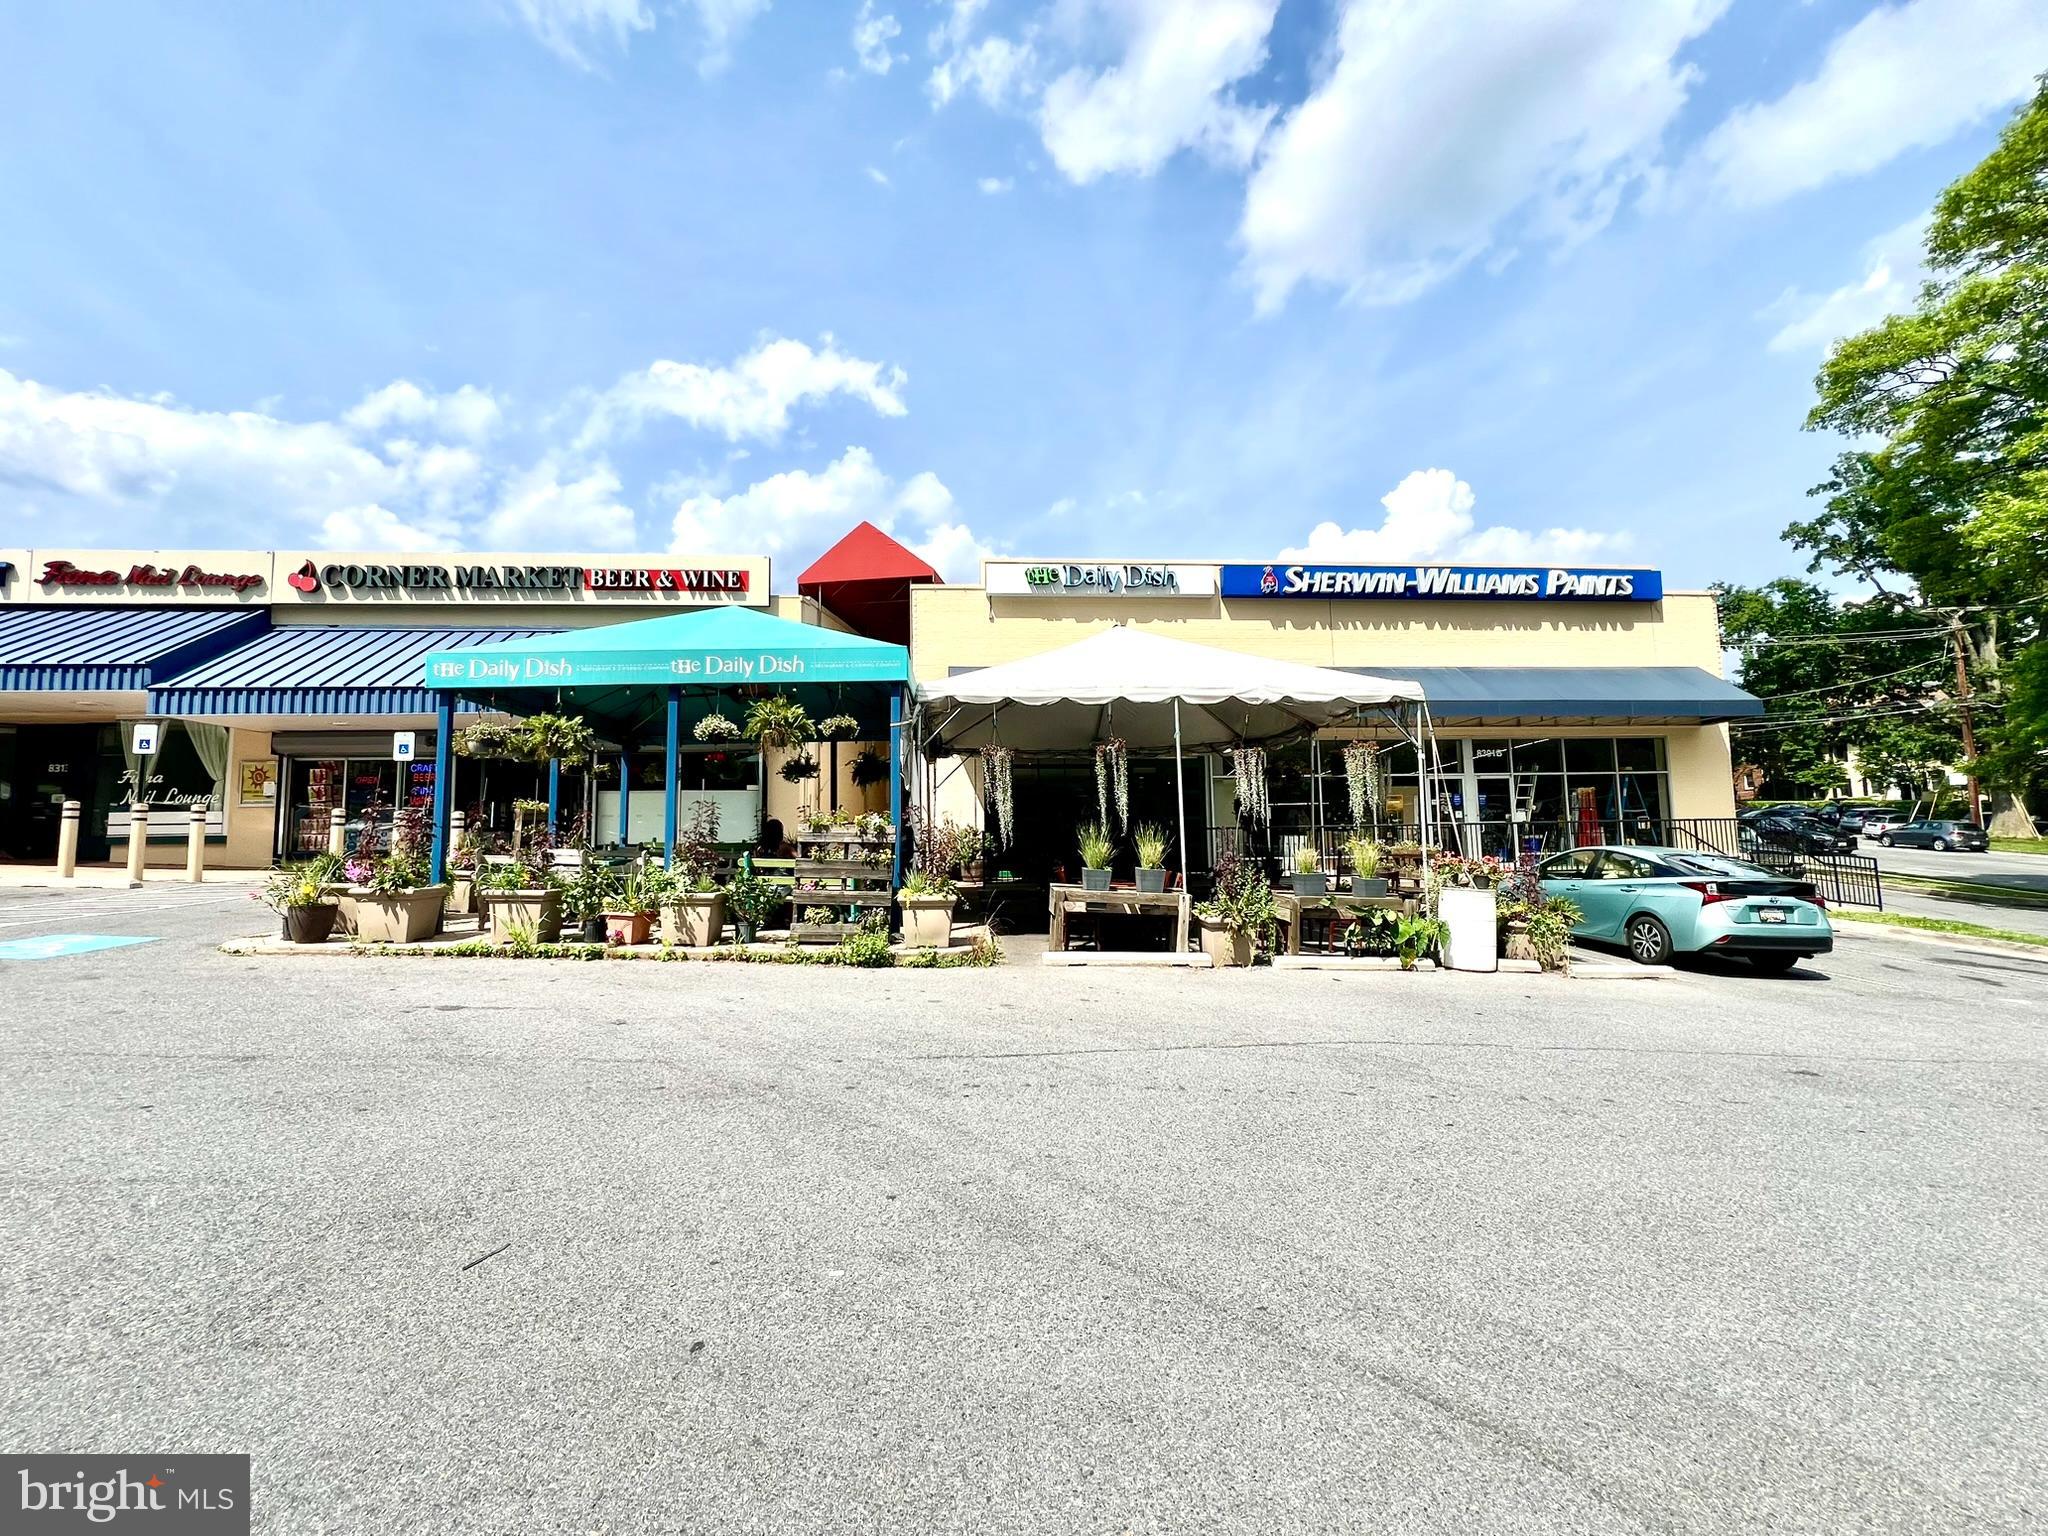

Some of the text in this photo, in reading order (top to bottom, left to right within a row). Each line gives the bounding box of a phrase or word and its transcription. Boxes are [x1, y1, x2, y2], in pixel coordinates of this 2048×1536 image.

[177, 565, 264, 592] Lounge
[320, 564, 583, 589] CORNER MARKET
[590, 569, 740, 588] BEER & WINE
[1063, 564, 1119, 592] Daily
[1123, 564, 1177, 587] Dish
[1546, 570, 1634, 595] PAINTS
[469, 659, 520, 681] Daily
[525, 657, 572, 678] Dish
[704, 656, 754, 678] Daily
[758, 655, 804, 674] Dish
[119, 787, 220, 806] Nil Lounge
